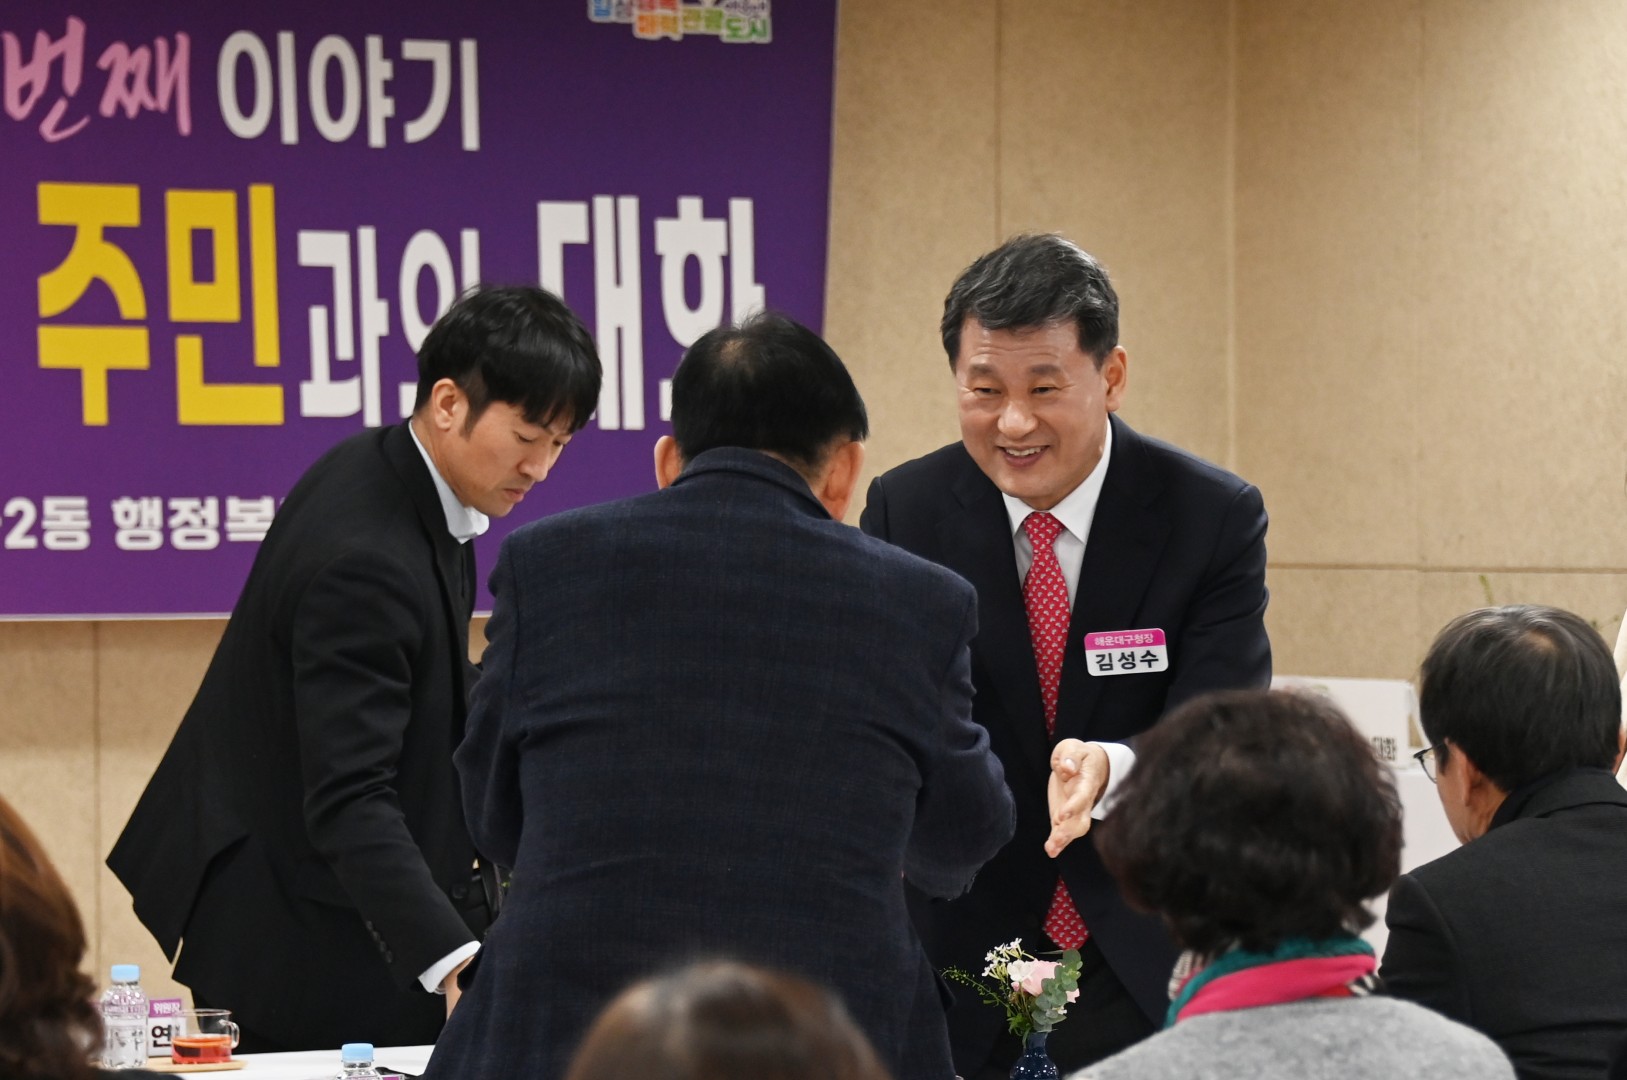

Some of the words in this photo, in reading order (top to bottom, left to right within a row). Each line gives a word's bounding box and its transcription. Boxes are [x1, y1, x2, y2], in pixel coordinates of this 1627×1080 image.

[2, 15, 192, 142] 번째
[217, 30, 480, 151] 이야기
[0, 496, 90, 550] 2동
[111, 496, 285, 550] 행정복
[1094, 633, 1154, 647] 해운대구청장
[1096, 650, 1159, 672] 김성수
[151, 1024, 180, 1049] 연
